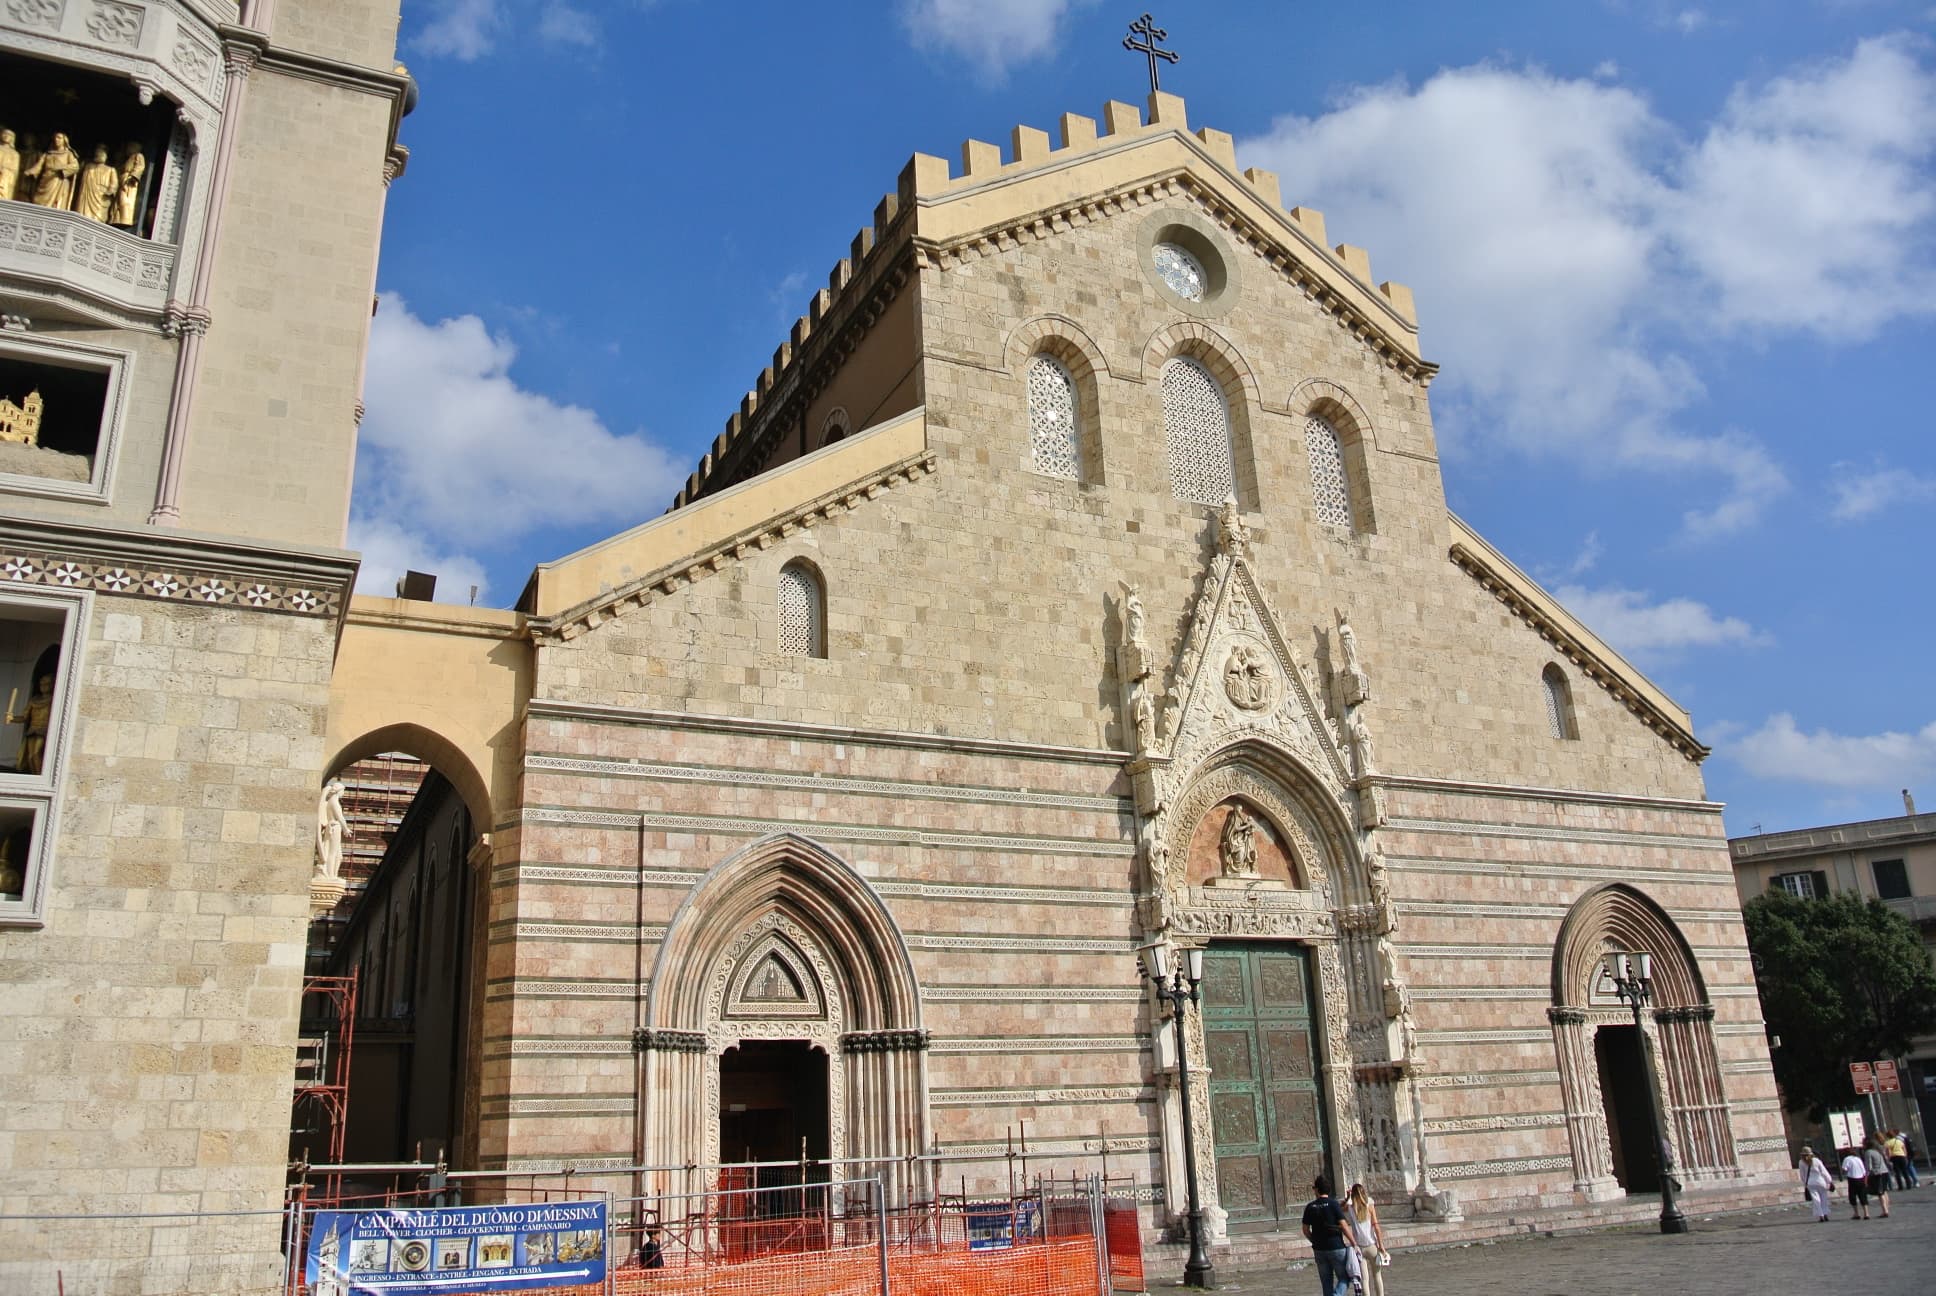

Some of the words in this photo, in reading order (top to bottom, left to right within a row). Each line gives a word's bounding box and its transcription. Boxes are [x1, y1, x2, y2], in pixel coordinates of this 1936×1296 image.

[359, 1214, 439, 1229] CAMPANILE
[441, 1213, 470, 1227] DEL
[471, 1210, 524, 1226] DUOMO
[527, 1210, 541, 1223] DI
[542, 1207, 598, 1221] MESSINA
[359, 1229, 379, 1238] BELL
[381, 1229, 411, 1237] TOWER
[415, 1228, 453, 1236] CLOCHER
[458, 1224, 517, 1235] GLOCKENTURM
[521, 1222, 571, 1231] CAMPANARIO
[396, 1273, 436, 1281] ENTRANCE
[472, 1269, 505, 1277] EINGANG
[509, 1267, 542, 1275] ENTRADA
